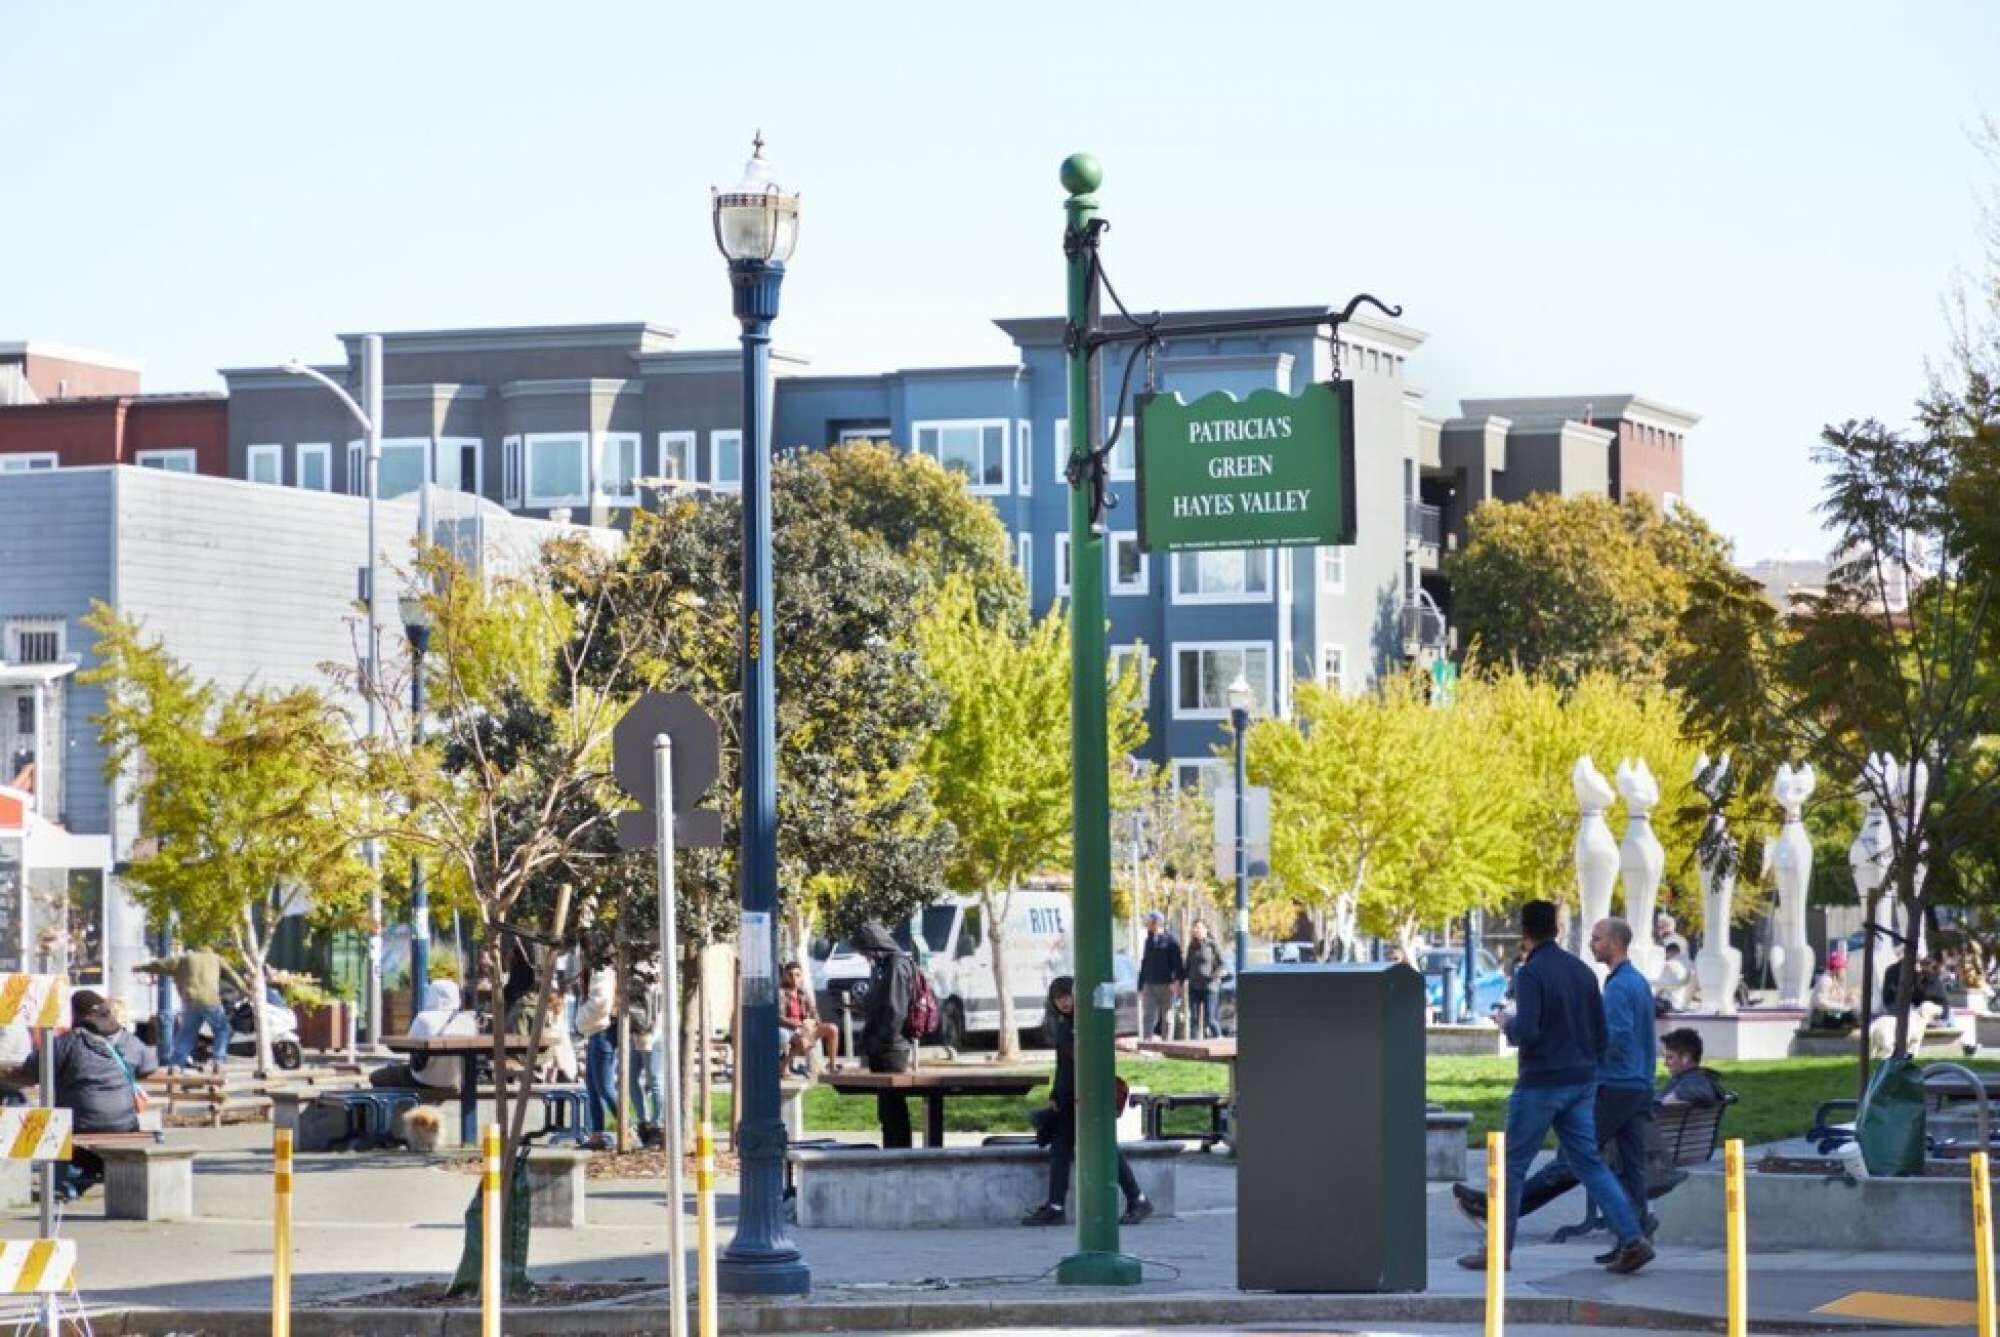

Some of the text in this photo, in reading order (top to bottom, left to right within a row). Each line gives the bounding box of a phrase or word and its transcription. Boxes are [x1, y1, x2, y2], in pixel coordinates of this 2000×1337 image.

[1189, 416, 1292, 443] PATRICIA'S
[1208, 455, 1273, 478] GREEN
[1173, 489, 1311, 517] HAYES VALLEY
[1029, 907, 1065, 934] RITE
